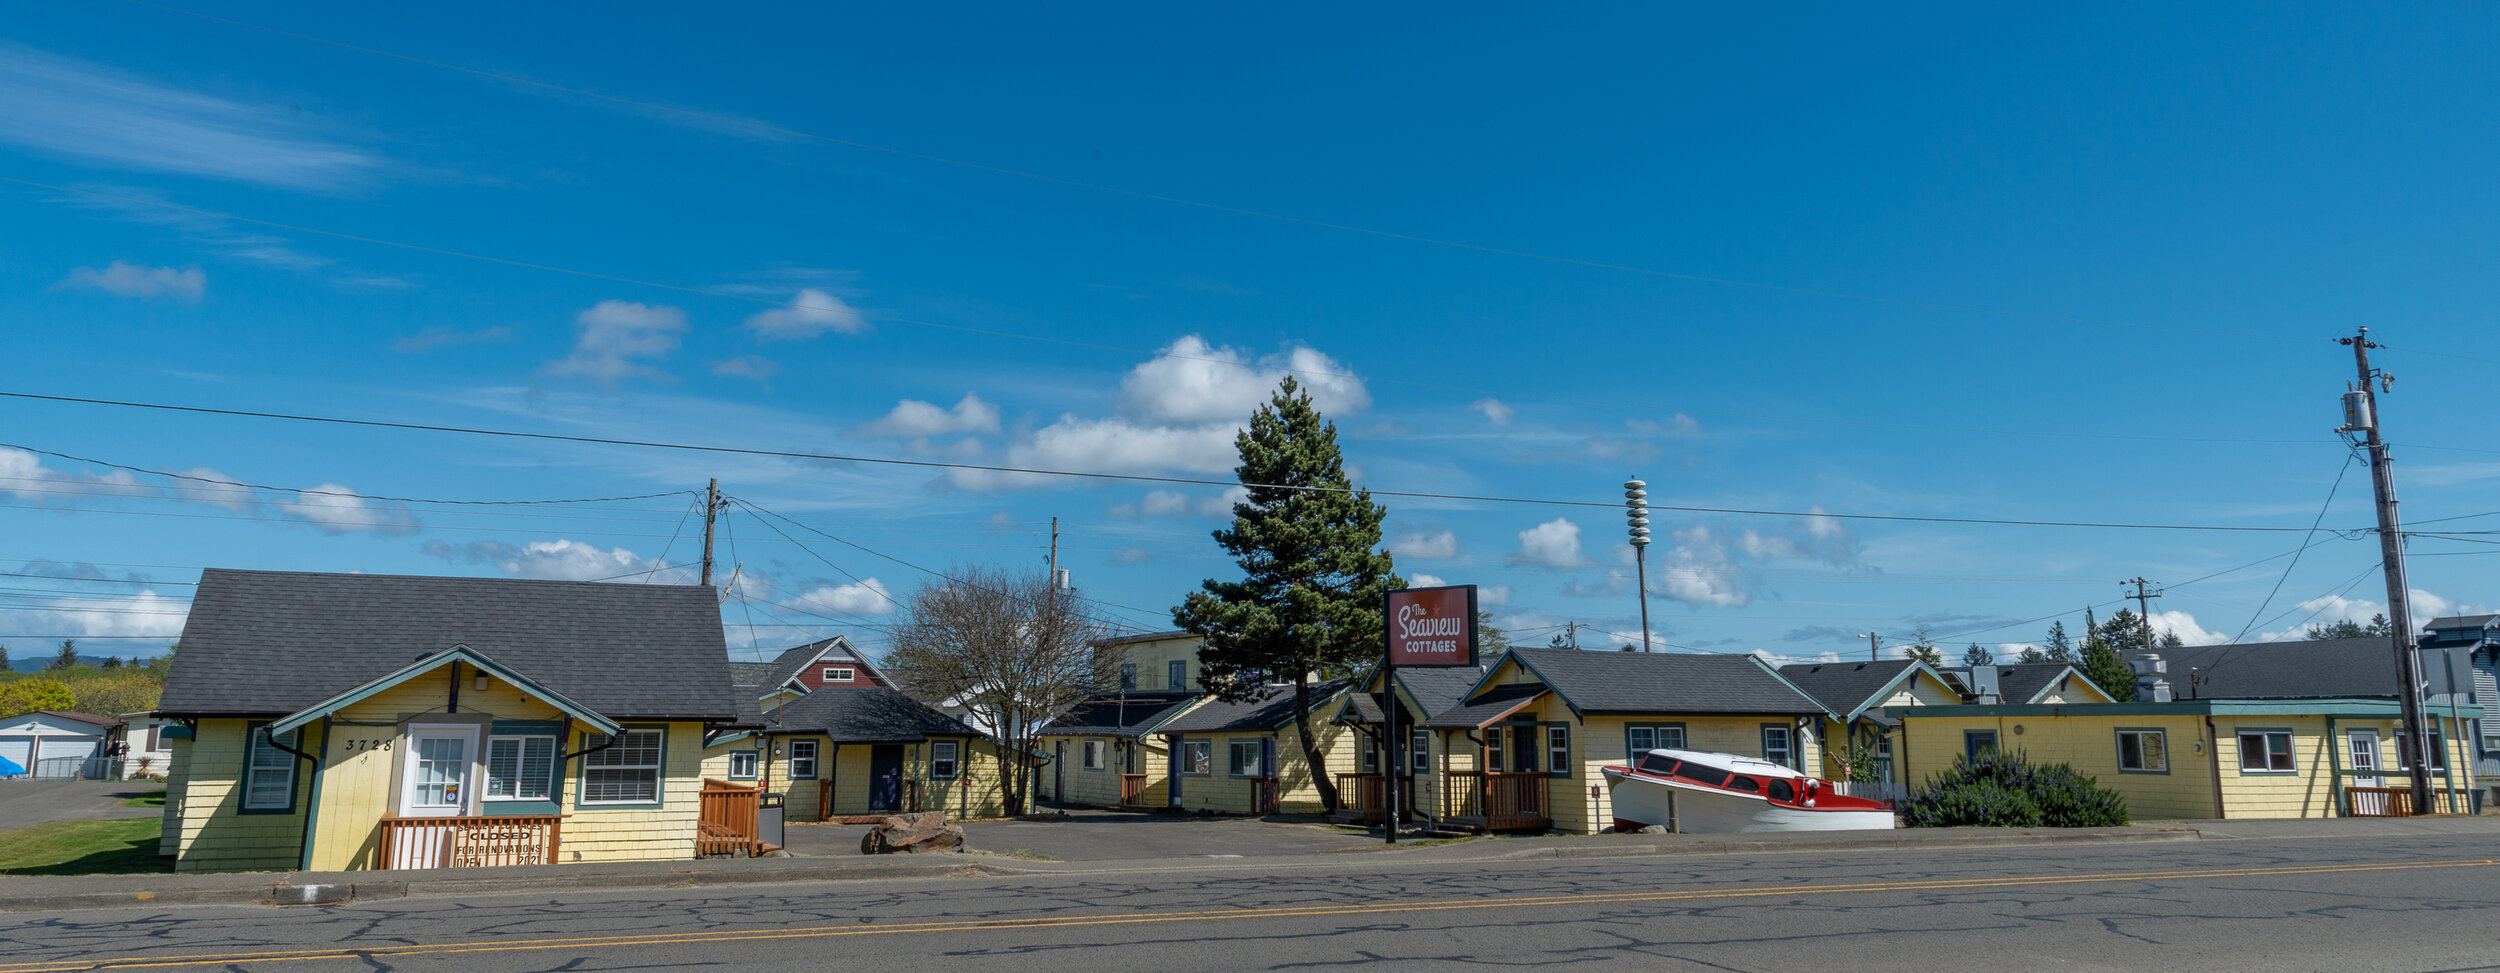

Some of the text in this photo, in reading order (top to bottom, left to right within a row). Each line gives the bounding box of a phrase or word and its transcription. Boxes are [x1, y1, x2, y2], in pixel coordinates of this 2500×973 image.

[1412, 603, 1427, 616] The
[1398, 605, 1460, 640] Seaview
[1406, 640, 1457, 653] COTTAGES
[345, 739, 392, 751] 3728
[458, 824, 495, 832] SEAVIE
[470, 832, 530, 840] CLOSED
[457, 846, 474, 854] FOR
[519, 855, 540, 865] 202
